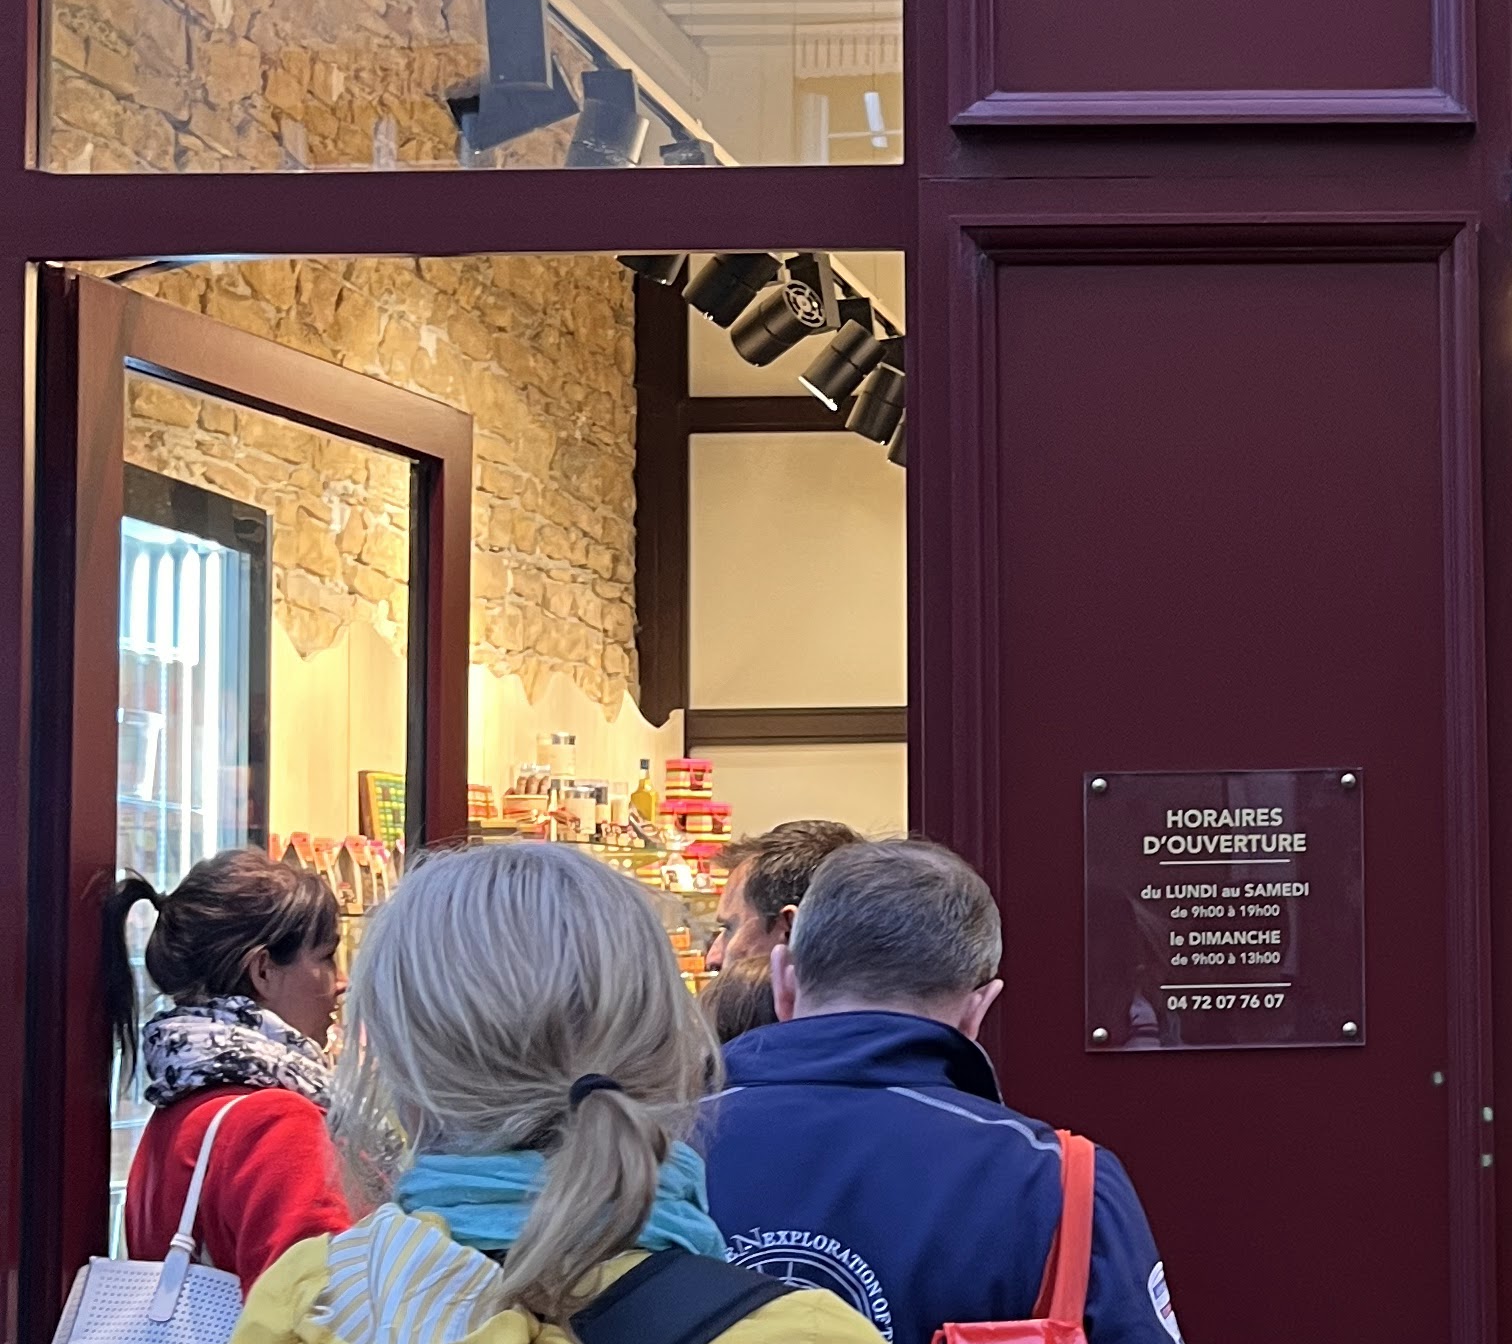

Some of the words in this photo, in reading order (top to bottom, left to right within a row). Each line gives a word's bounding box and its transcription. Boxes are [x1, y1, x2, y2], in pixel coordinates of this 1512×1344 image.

[1166, 808, 1283, 828] HORAIRES
[1143, 833, 1307, 855] D'OUVERTURE
[1140, 884, 1162, 900] du
[1165, 883, 1217, 899] LUNDI
[1221, 886, 1241, 898] au
[1244, 882, 1309, 898] SAMEDI
[1170, 906, 1188, 919] de
[1191, 905, 1225, 918] 9h00
[1227, 904, 1236, 918] à
[1239, 904, 1281, 918] 19h00
[1170, 931, 1185, 947] le
[1188, 930, 1281, 946] DIMANCHE
[1170, 953, 1188, 966] de
[1191, 952, 1225, 966] 9h00
[1227, 951, 1236, 965] à
[1239, 951, 1281, 965] 13h00
[1167, 995, 1188, 1010] 04
[1191, 995, 1213, 1010] 72
[1215, 994, 1236, 1009] 07
[1239, 994, 1261, 1009] 76
[1263, 993, 1285, 1008] 07
